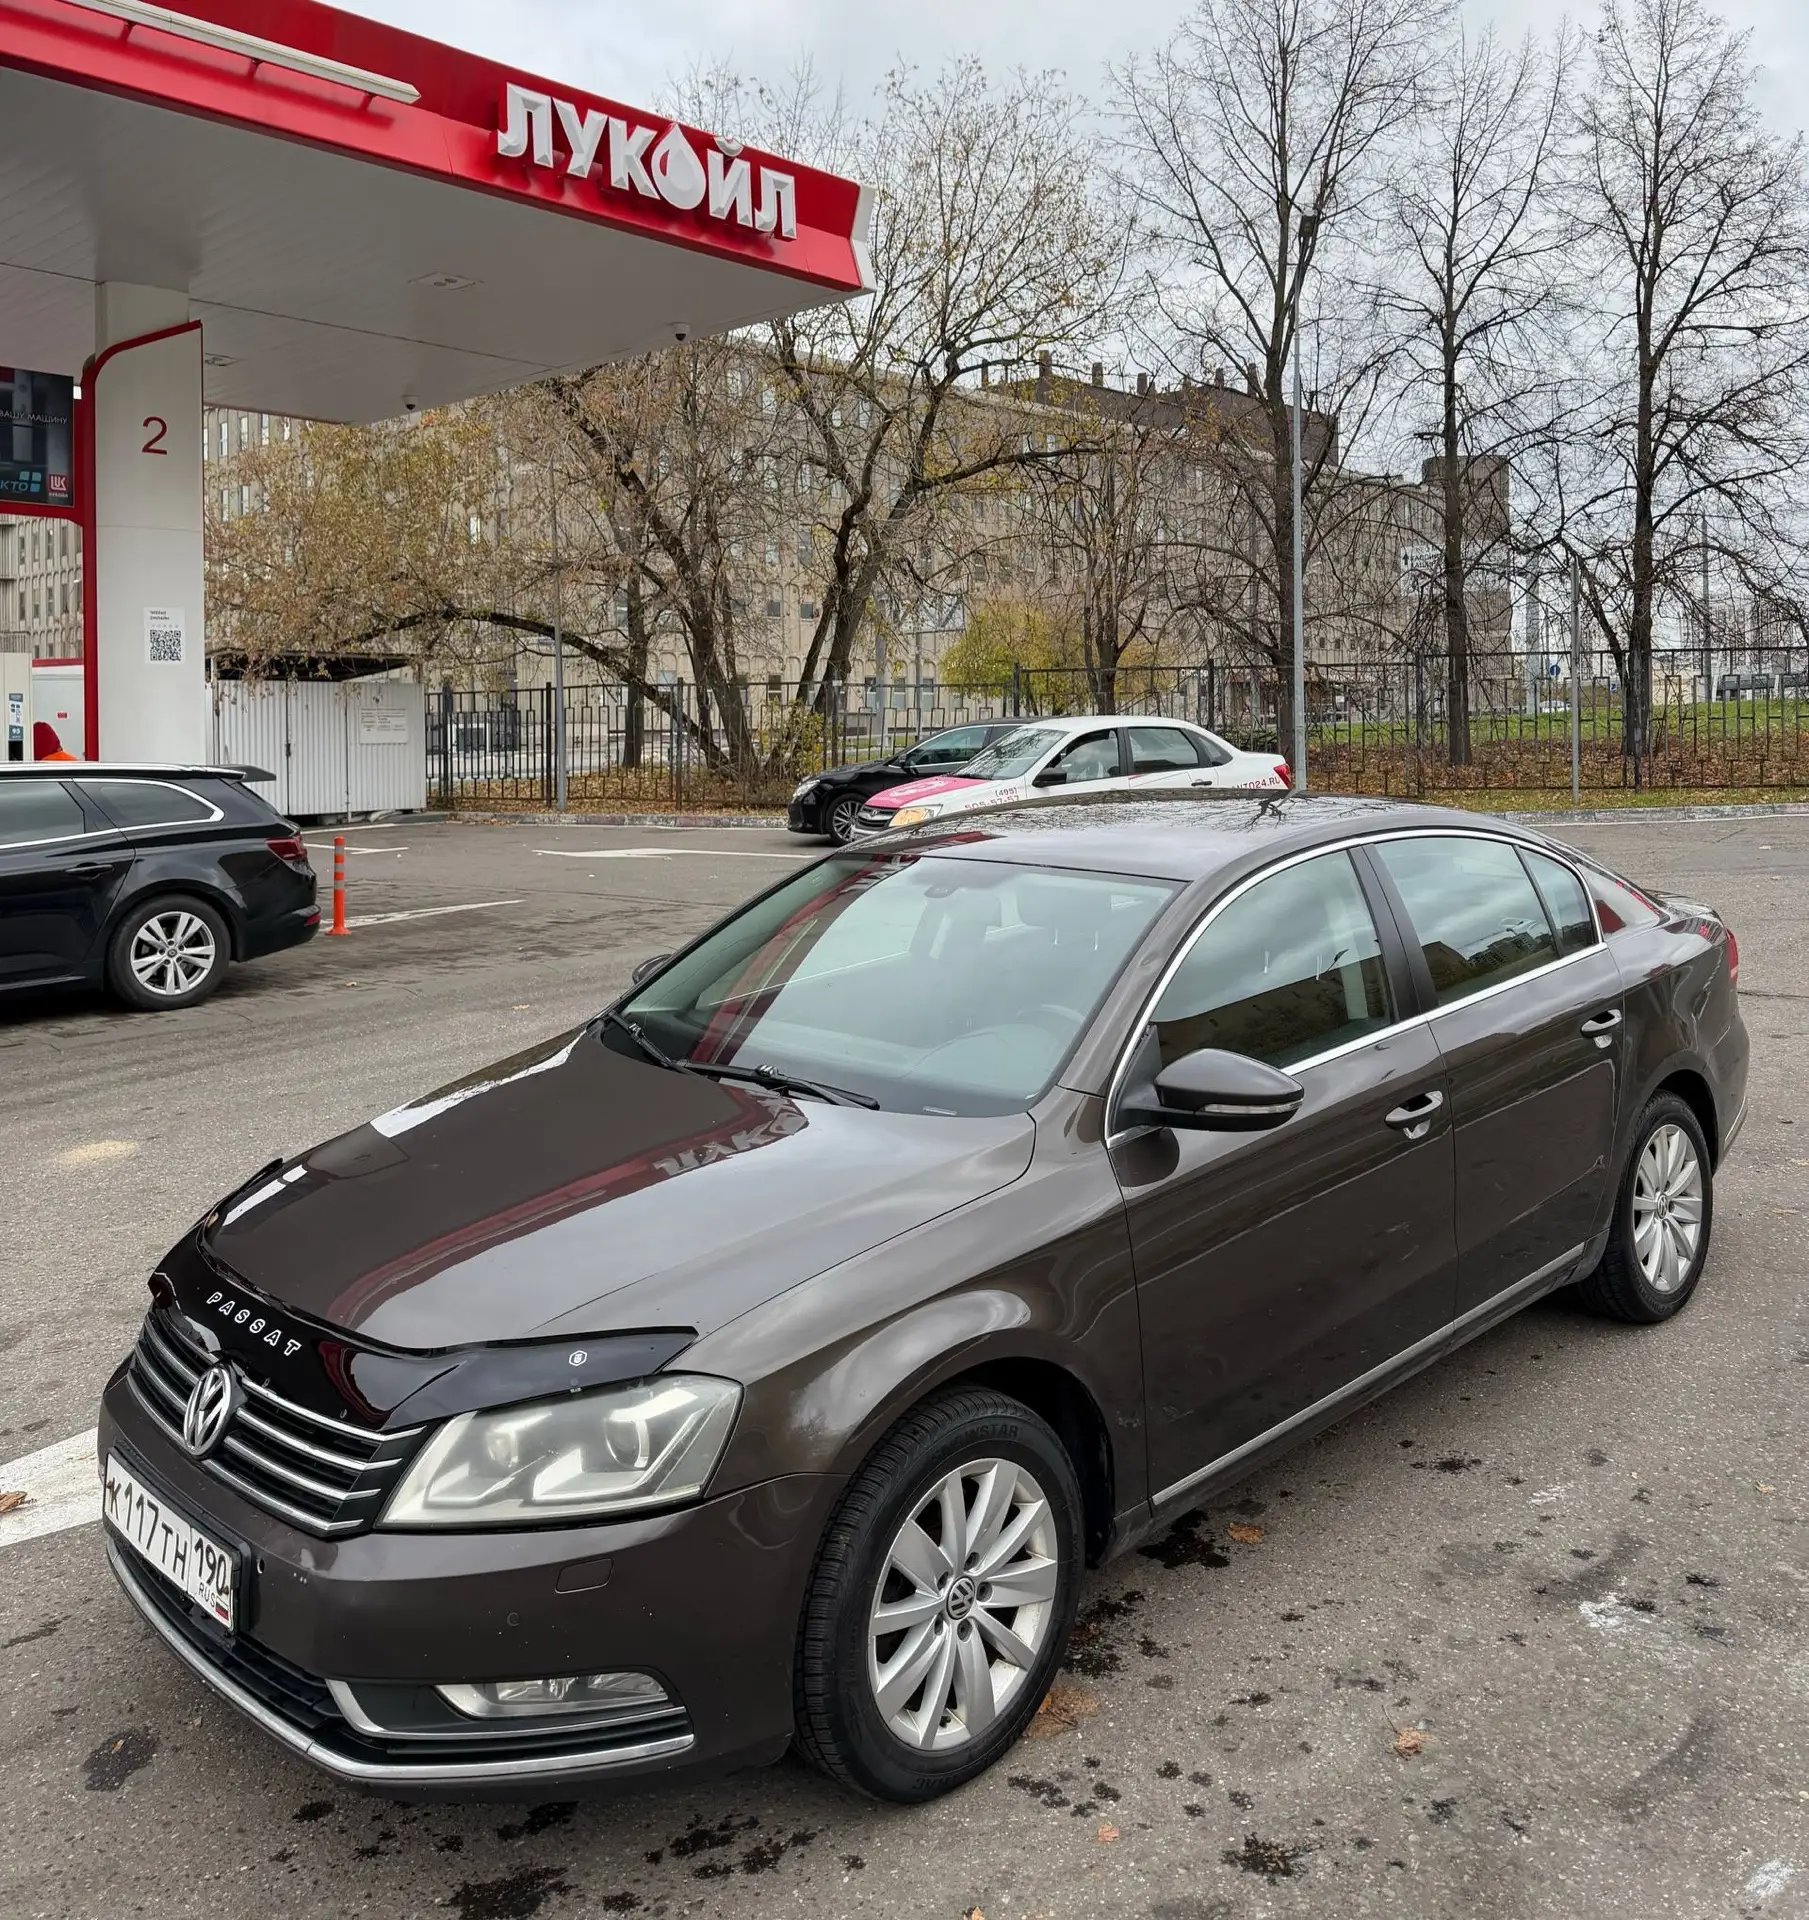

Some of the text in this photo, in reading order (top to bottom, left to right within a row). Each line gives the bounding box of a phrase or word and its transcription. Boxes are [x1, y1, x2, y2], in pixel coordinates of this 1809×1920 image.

[497, 82, 798, 240] ЛУКОЙЛ
[27, 412, 67, 425] МАШИНУ
[142, 416, 168, 455] 2
[206, 1291, 302, 1356] PASSAT
[194, 1537, 228, 1597] 190
[199, 1582, 216, 1608] RUS
